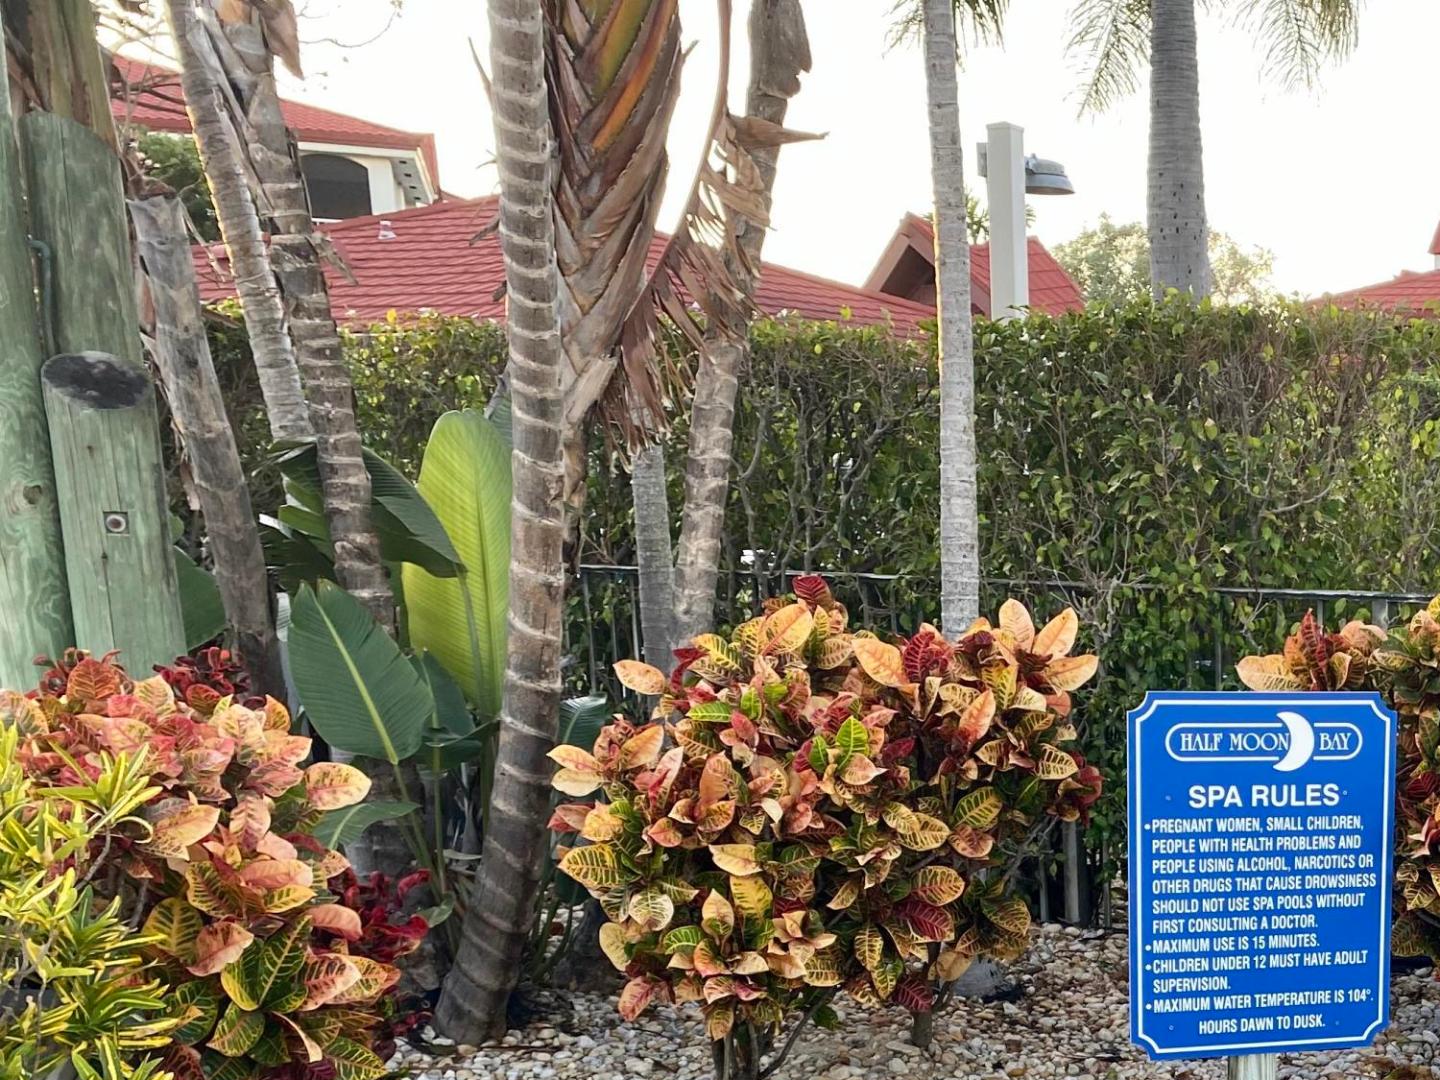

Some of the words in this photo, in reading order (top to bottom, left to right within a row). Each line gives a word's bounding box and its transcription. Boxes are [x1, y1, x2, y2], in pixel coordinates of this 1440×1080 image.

[1180, 733, 1223, 751] HALF
[1230, 733, 1290, 751] MOON
[1319, 733, 1352, 750] BAY
[1189, 785, 1242, 808] SPA
[1251, 784, 1339, 807] RULES
[1152, 818, 1213, 833] PREGNANT
[1216, 817, 1263, 833] WOMEN,
[1266, 816, 1303, 831] SMALL
[1307, 815, 1363, 831] CHILDREN,
[1153, 838, 1195, 853] PEOPLE
[1199, 838, 1228, 852] WITH
[1232, 837, 1273, 851] HEALTH
[1276, 836, 1335, 850] PROBLEMS
[1339, 835, 1361, 849] AND
[1153, 858, 1195, 873] PEOPLE
[1199, 857, 1233, 872] USING
[1237, 856, 1291, 872] ALCOHOL,
[1295, 855, 1355, 869] NARCOTICS
[1358, 854, 1374, 867] OR
[1153, 879, 1189, 893] OTHER
[1193, 878, 1232, 892] DRUGS
[1235, 877, 1262, 891] THAT
[1266, 876, 1301, 891] CAUSE
[1305, 874, 1376, 889] DROWSINESS
[1153, 899, 1198, 914] SHOULD
[1203, 899, 1224, 912] NOT
[1228, 898, 1249, 911] USE
[1253, 897, 1274, 910] SPA
[1277, 895, 1312, 910] POOLS
[1316, 893, 1365, 907] WITHOUT
[1153, 920, 1184, 934] FIRST
[1188, 917, 1257, 933] CONSULTING
[1261, 916, 1268, 929] A
[1271, 915, 1317, 929] DOCTOR.
[1153, 939, 1209, 953] MAXIMUM
[1213, 938, 1234, 951] USE
[1238, 937, 1249, 950] IS
[1252, 937, 1265, 950] 15
[1268, 934, 1319, 949] MINUTES.
[1153, 958, 1209, 973] CHILDREN
[1212, 957, 1250, 971] UNDER
[1253, 956, 1265, 969] 12
[1269, 954, 1300, 969] MUST
[1303, 953, 1331, 967] HAVE
[1334, 951, 1368, 965] ADULT
[1154, 977, 1230, 993] SUPERVISION.
[1154, 998, 1210, 1013] MAXIMUM
[1214, 996, 1251, 1009] WATER
[1254, 991, 1331, 1008] TEMPERATURE
[1334, 990, 1344, 1003] IS
[1199, 1018, 1237, 1034] HOURS
[1241, 1017, 1273, 1031] DAWN
[1277, 1016, 1290, 1030] TO
[1294, 1015, 1325, 1029] DUSK.
